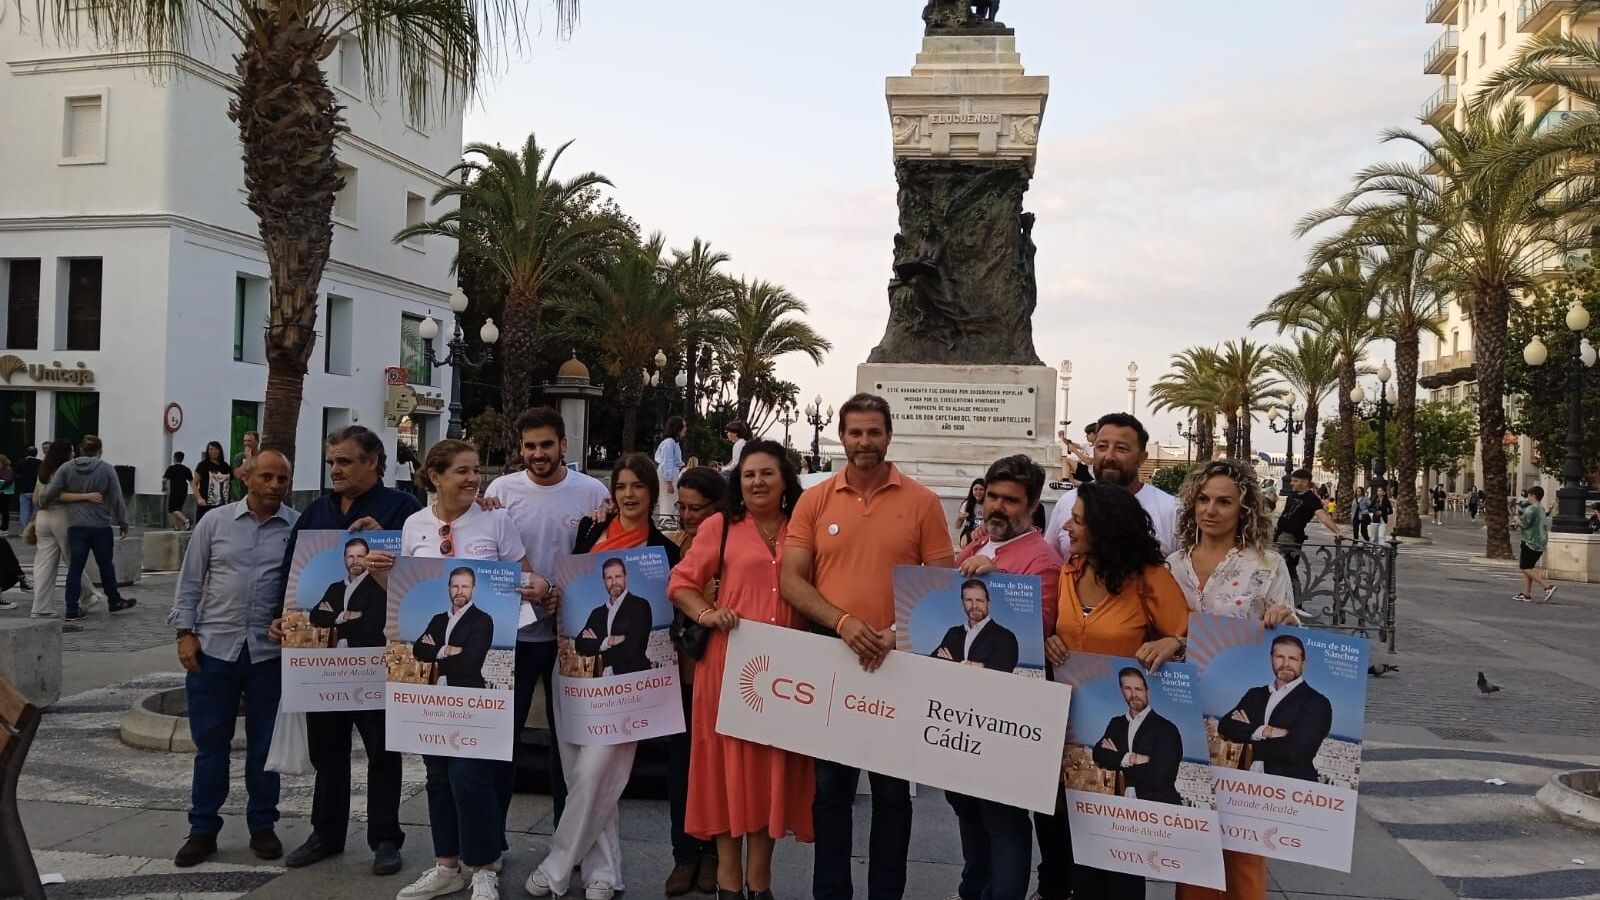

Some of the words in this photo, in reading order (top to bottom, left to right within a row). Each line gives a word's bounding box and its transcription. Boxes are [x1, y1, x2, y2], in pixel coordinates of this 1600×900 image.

[931, 114, 999, 125] ELOCUENCIA
[29, 360, 95, 386] Unicaja
[990, 580, 1006, 589] Juan
[1007, 581, 1016, 589] de
[1017, 582, 1034, 590] Dios
[1004, 588, 1033, 597] Sánchez
[1305, 638, 1327, 649] Juan
[1328, 642, 1339, 651] de
[1341, 644, 1360, 654] Dios
[290, 656, 367, 667] REVIVAMOS
[1324, 649, 1359, 662] Sánchez
[1161, 678, 1190, 687] Sánchez
[1163, 670, 1172, 678] de
[1173, 671, 1190, 680] Dios
[564, 683, 632, 698] REVIVAMOS
[636, 676, 673, 691] CÁDIZ
[771, 677, 816, 705] CS
[319, 691, 350, 701] VOTA
[364, 691, 382, 699] CS
[393, 692, 464, 707] REVIVAMOS
[467, 695, 506, 710] CÁDIZ
[446, 710, 473, 719] Alcalde
[844, 694, 896, 719] Cádiz
[587, 724, 618, 735] VOTA
[632, 719, 649, 729] CS
[926, 699, 1042, 742] Revivamos
[418, 733, 446, 745] VOTA
[460, 737, 478, 746] CS
[923, 725, 982, 755] Cádiz
[1226, 797, 1260, 810] Juande
[1262, 800, 1299, 816] Alcalde
[1291, 789, 1345, 812] CÁDIZ
[1075, 801, 1159, 825] REVIVAMOS
[1163, 813, 1210, 832] CÁDIZ
[1111, 822, 1139, 834] Juande
[1141, 827, 1172, 839] Alcalde
[1220, 824, 1259, 842] VOTA
[1279, 836, 1302, 848] CS
[1109, 849, 1144, 864] VOTA
[1160, 858, 1181, 869] CS
